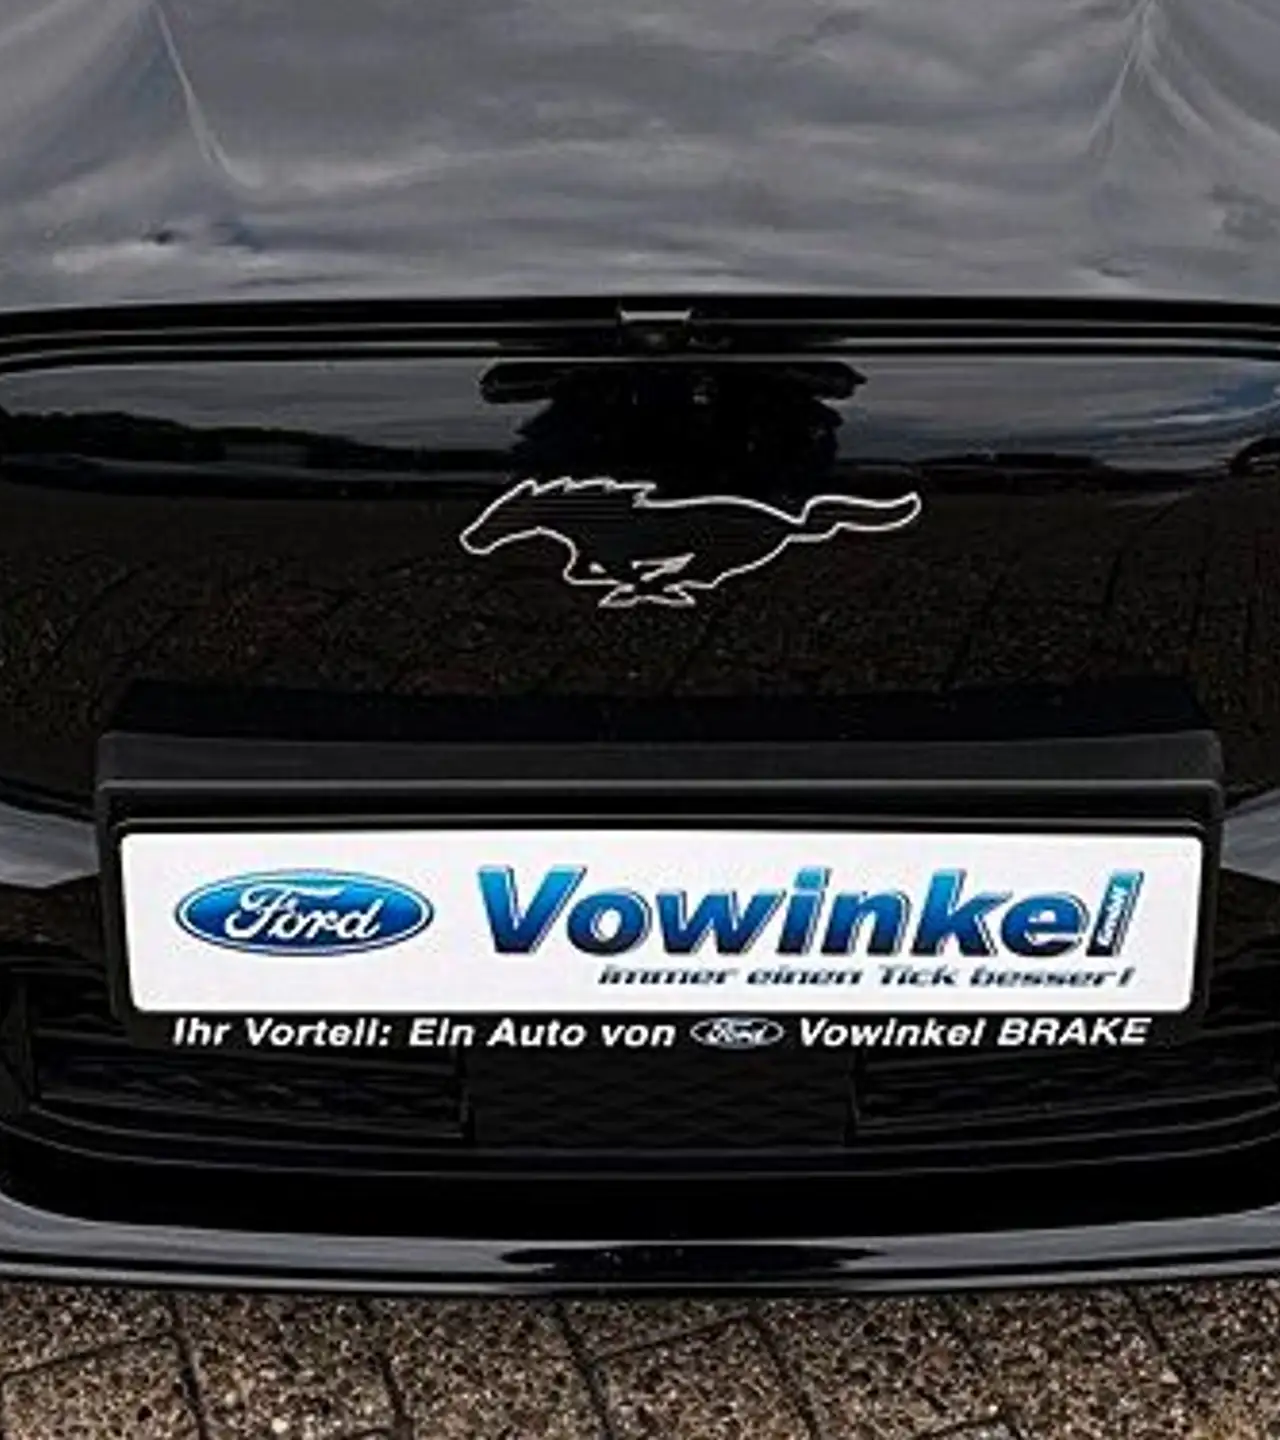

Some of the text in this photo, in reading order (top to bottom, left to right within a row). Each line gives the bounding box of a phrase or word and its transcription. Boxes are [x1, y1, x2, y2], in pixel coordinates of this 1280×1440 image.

[224, 866, 1144, 958] Ford Vowinkel
[598, 965, 738, 986] immer
[746, 965, 863, 986] einen
[879, 964, 957, 987] Tick
[173, 1017, 232, 1047] Ihr
[245, 1017, 392, 1047] Vorteil:
[408, 1017, 475, 1047] Ein
[486, 1017, 587, 1047] Auto
[601, 1024, 676, 1047] von
[800, 1017, 987, 1047] Vowinkel
[998, 1017, 1153, 1047] BRAKE
